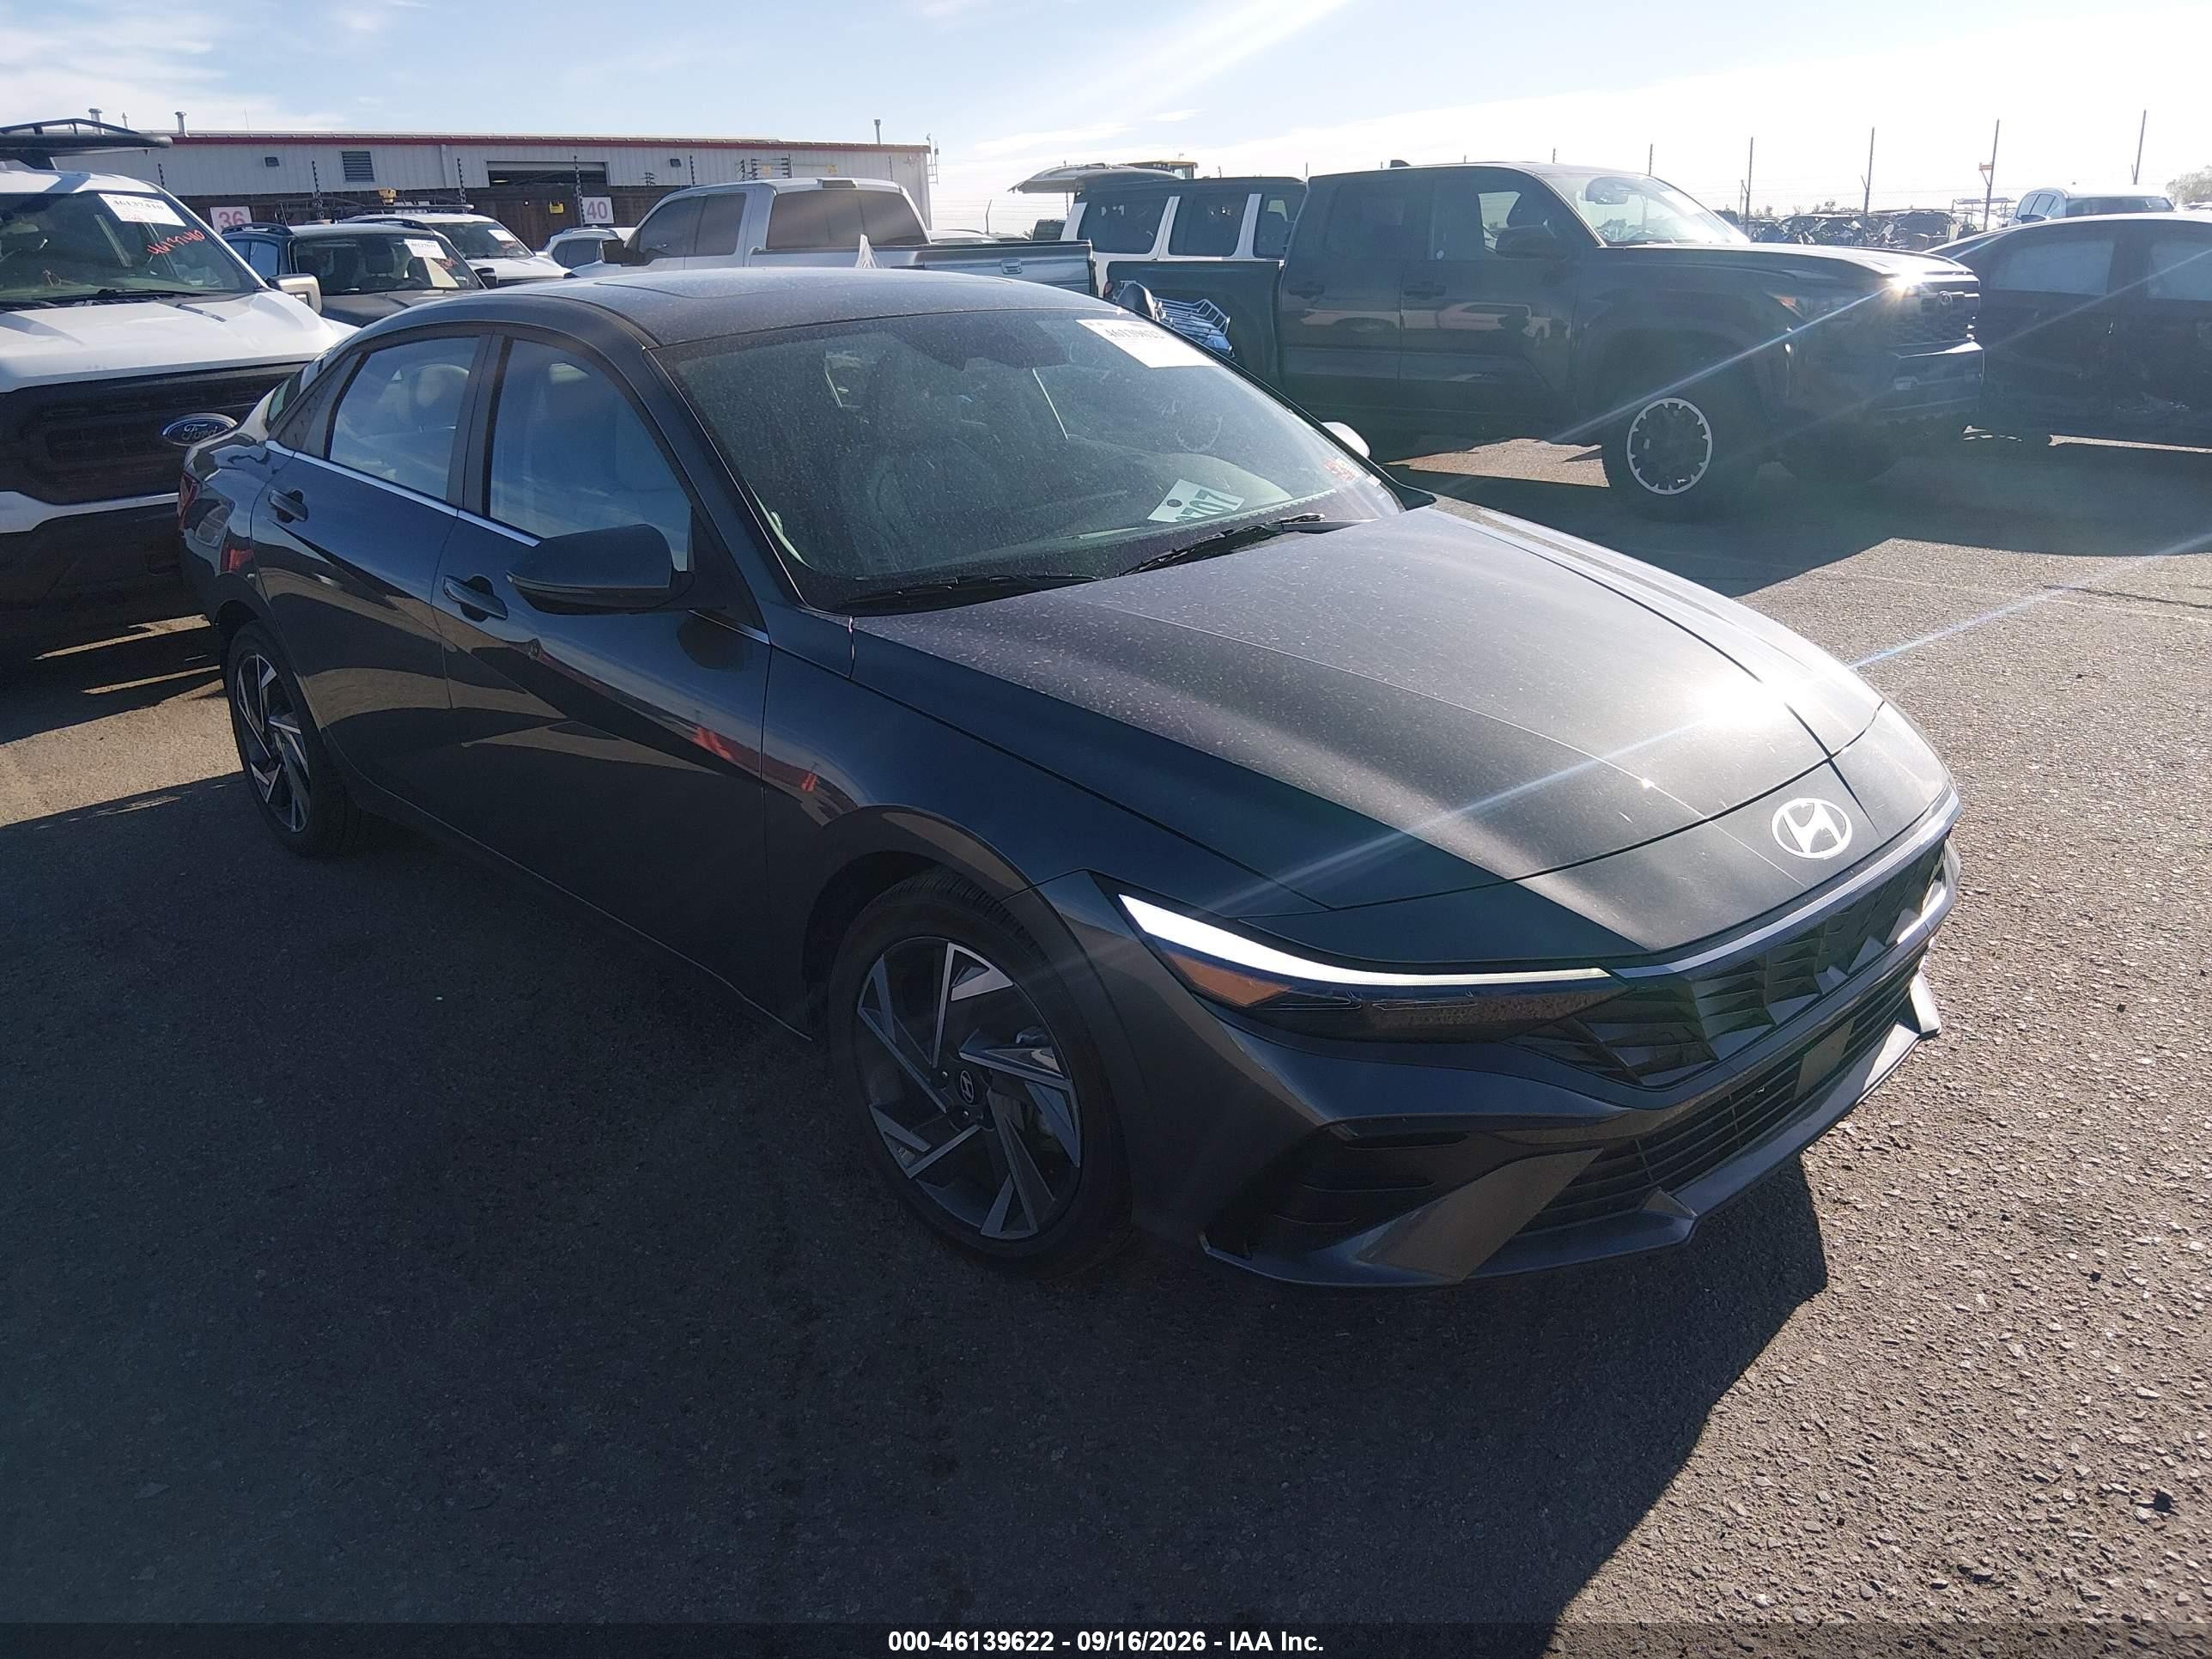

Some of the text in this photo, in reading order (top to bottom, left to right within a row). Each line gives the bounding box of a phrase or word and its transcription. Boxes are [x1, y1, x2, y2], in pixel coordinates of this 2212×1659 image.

[587, 201, 608, 219] 40
[218, 211, 246, 228] 36
[181, 423, 218, 441] Ford
[1175, 489, 1239, 523] 707
